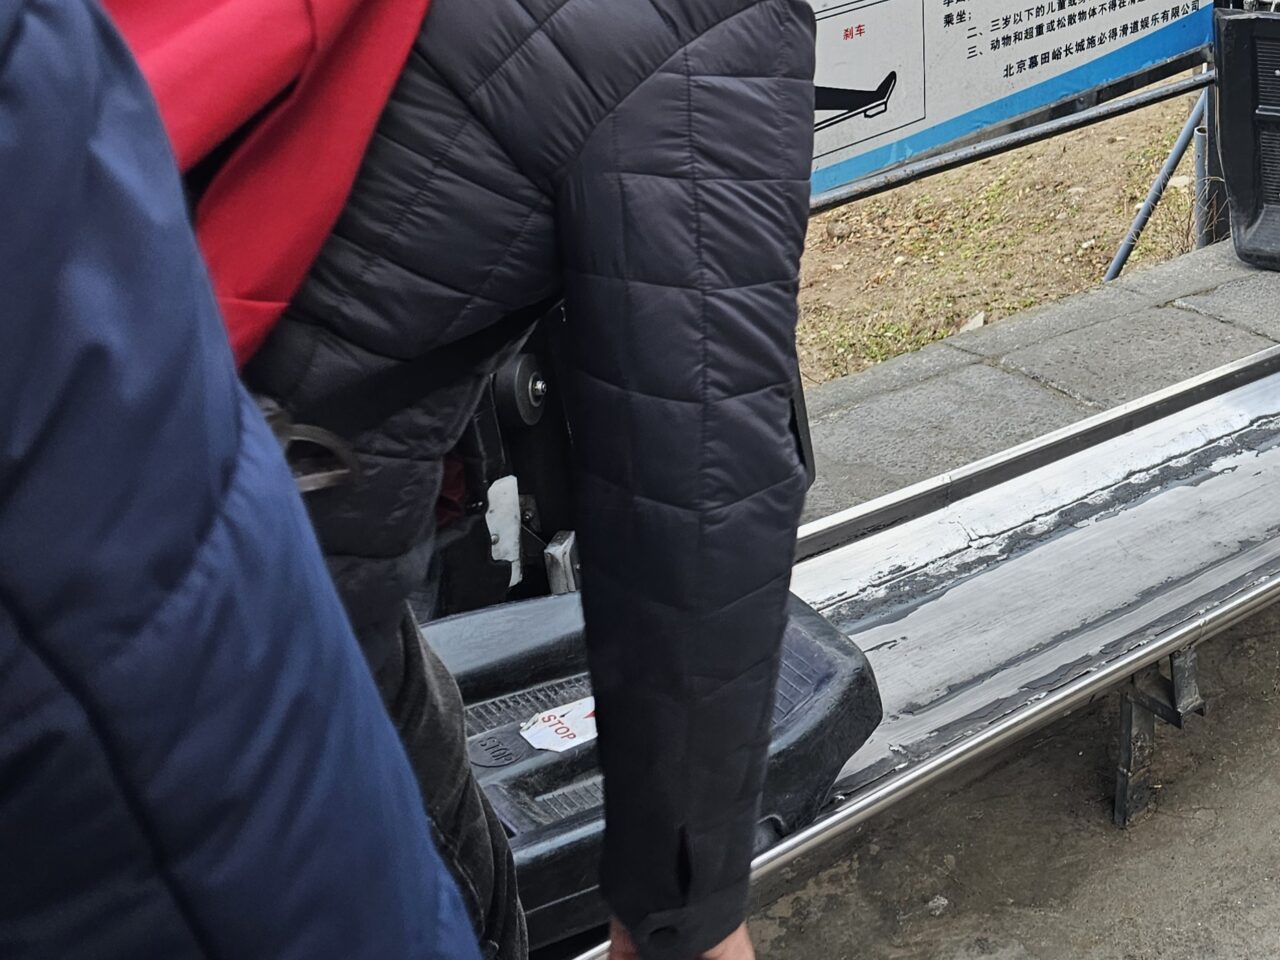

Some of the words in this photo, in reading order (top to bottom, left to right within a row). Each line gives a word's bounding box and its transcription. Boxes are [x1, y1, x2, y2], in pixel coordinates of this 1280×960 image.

[843, 24, 865, 40] 刹车
[542, 714, 576, 740] STOP
[479, 736, 512, 761] STOP
